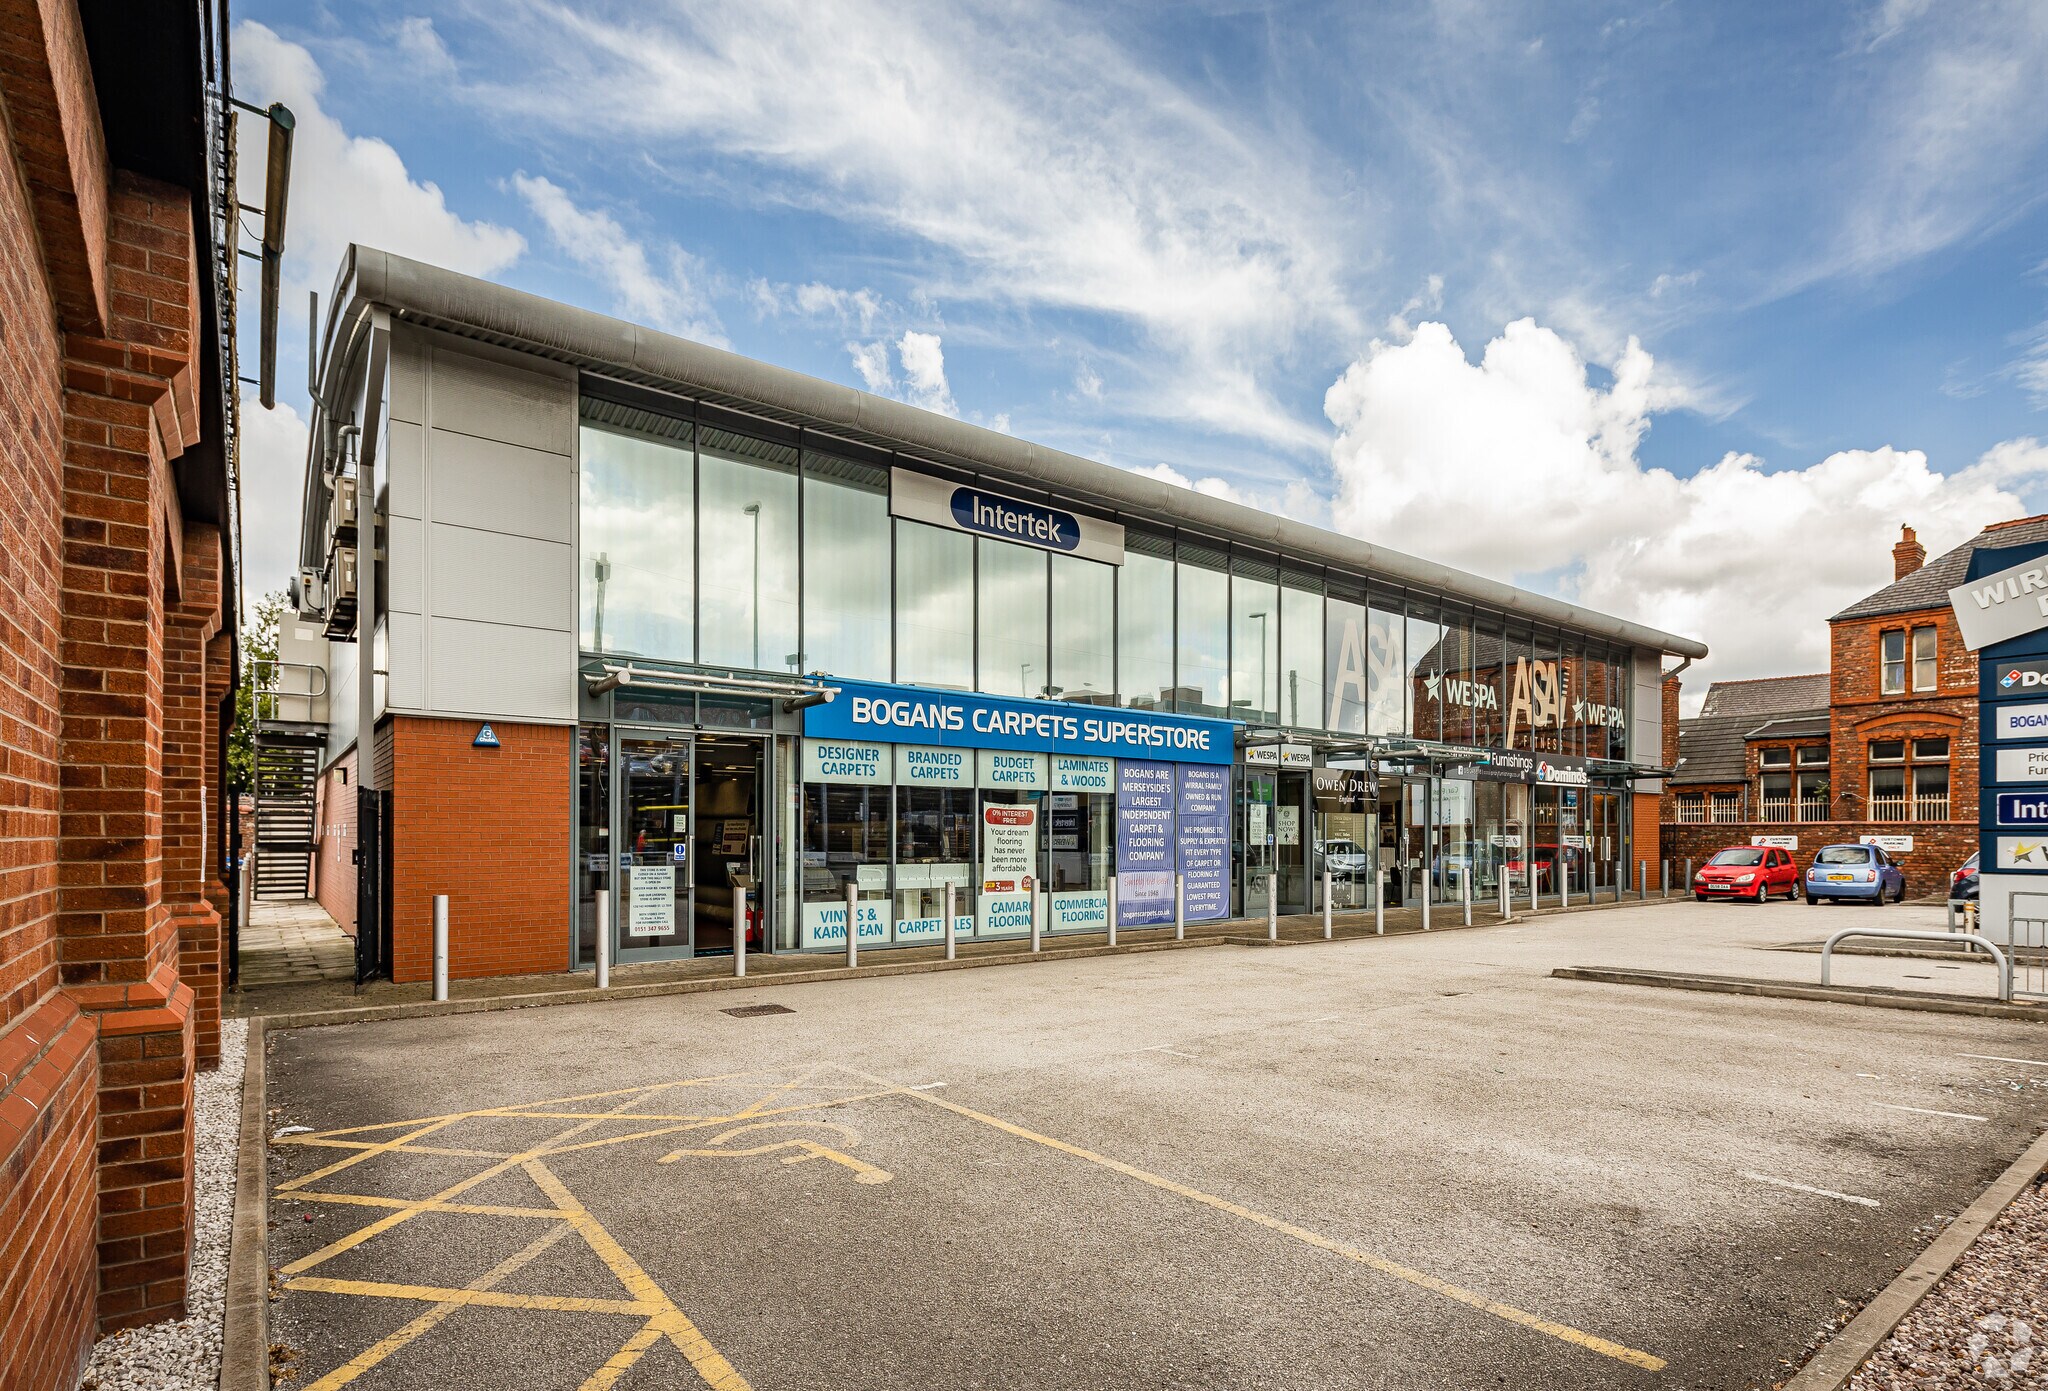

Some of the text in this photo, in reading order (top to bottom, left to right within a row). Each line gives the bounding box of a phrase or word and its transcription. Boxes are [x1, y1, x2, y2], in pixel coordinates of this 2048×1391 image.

[972, 494, 1062, 543] Intertek
[1971, 565, 2048, 609] WIR
[1328, 618, 1404, 732] ASA
[1445, 677, 1498, 711] WESPA
[1587, 702, 1625, 729] WESPA
[852, 696, 1210, 751] BOGANS CARPETS SUPERSTORE
[818, 745, 880, 762] DESIGNER
[907, 751, 962, 766] BRANDED
[1256, 750, 1278, 760] WESPA
[1290, 752, 1311, 763] WESPA
[993, 756, 1035, 770] BUDGET
[1058, 758, 1109, 773] LAMINATES
[1491, 753, 1534, 773] Furnishings
[821, 761, 876, 777] CARPETS
[910, 765, 959, 780] CARPETS
[1124, 768, 1169, 780] BOGANS ARE
[1188, 770, 1210, 779] BOGANS
[1210, 771, 1215, 779] IS
[1547, 765, 1588, 783] Domino's
[992, 770, 1036, 783] CARPETS
[1060, 774, 1106, 788] & WOODS
[1122, 783, 1171, 793] MERSEYSIDE'S
[1184, 781, 1222, 790] WIRRAL FAMILY
[1316, 776, 1377, 793] OWEN DREW
[1131, 796, 1162, 806] LARGEST
[1185, 793, 1222, 801] OWNED & RUN
[1338, 795, 1355, 805] England
[2013, 799, 2048, 819] Int
[1122, 810, 1171, 820] INDEPENDENT
[990, 828, 1029, 836] Your dream
[1130, 824, 1164, 834] CARPET &
[1184, 826, 1223, 834] WE PROMISE TO
[997, 837, 1023, 846] flooring
[1129, 837, 1165, 847] FLOORING
[1180, 837, 1198, 846] SUPPLY
[1204, 837, 1227, 845] EXPERTLY
[993, 846, 1006, 854] has
[1185, 848, 1222, 856] FIT EVERY TYPE
[991, 855, 1008, 863] been
[1129, 851, 1164, 861] COMPANY
[1186, 860, 1194, 868] OF
[1187, 870, 1220, 879] FLOORING AT
[995, 882, 1001, 891] 3
[1186, 881, 1221, 890] GUARANTEED
[1134, 889, 1147, 897] Since
[1186, 892, 1221, 901] LOWEST PRICE
[991, 901, 1031, 914] CAMAR
[1054, 898, 1107, 910] COMMERCIA
[820, 908, 877, 923] VINYS &
[1061, 910, 1105, 922] FLOORING
[1123, 908, 1170, 919] boganscarpets.co.uk
[898, 919, 942, 934] CARPET
[988, 914, 1032, 928] FLOORIN
[813, 923, 883, 940] KARNEAN
